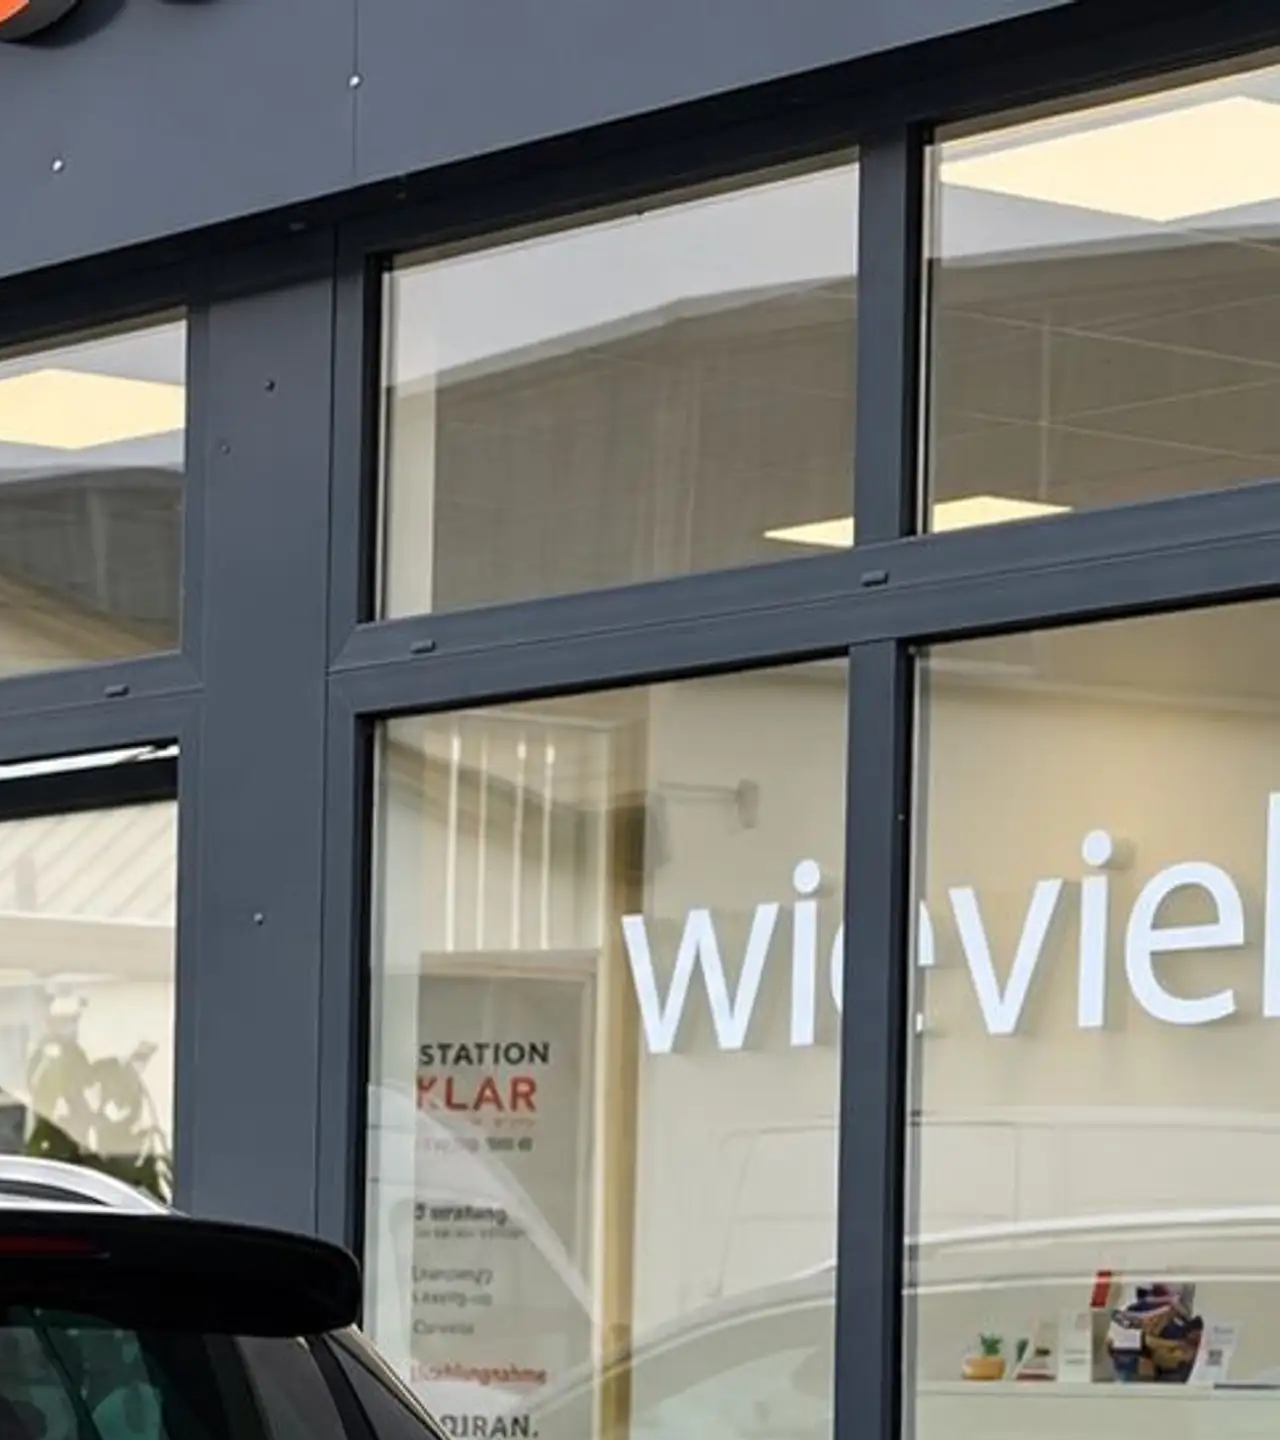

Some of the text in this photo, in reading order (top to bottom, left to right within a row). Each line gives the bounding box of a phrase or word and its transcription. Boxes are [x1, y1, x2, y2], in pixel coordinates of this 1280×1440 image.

[622, 792, 1280, 1054] wiviel
[419, 1041, 550, 1066] STATION
[416, 1076, 537, 1112] KLAR
